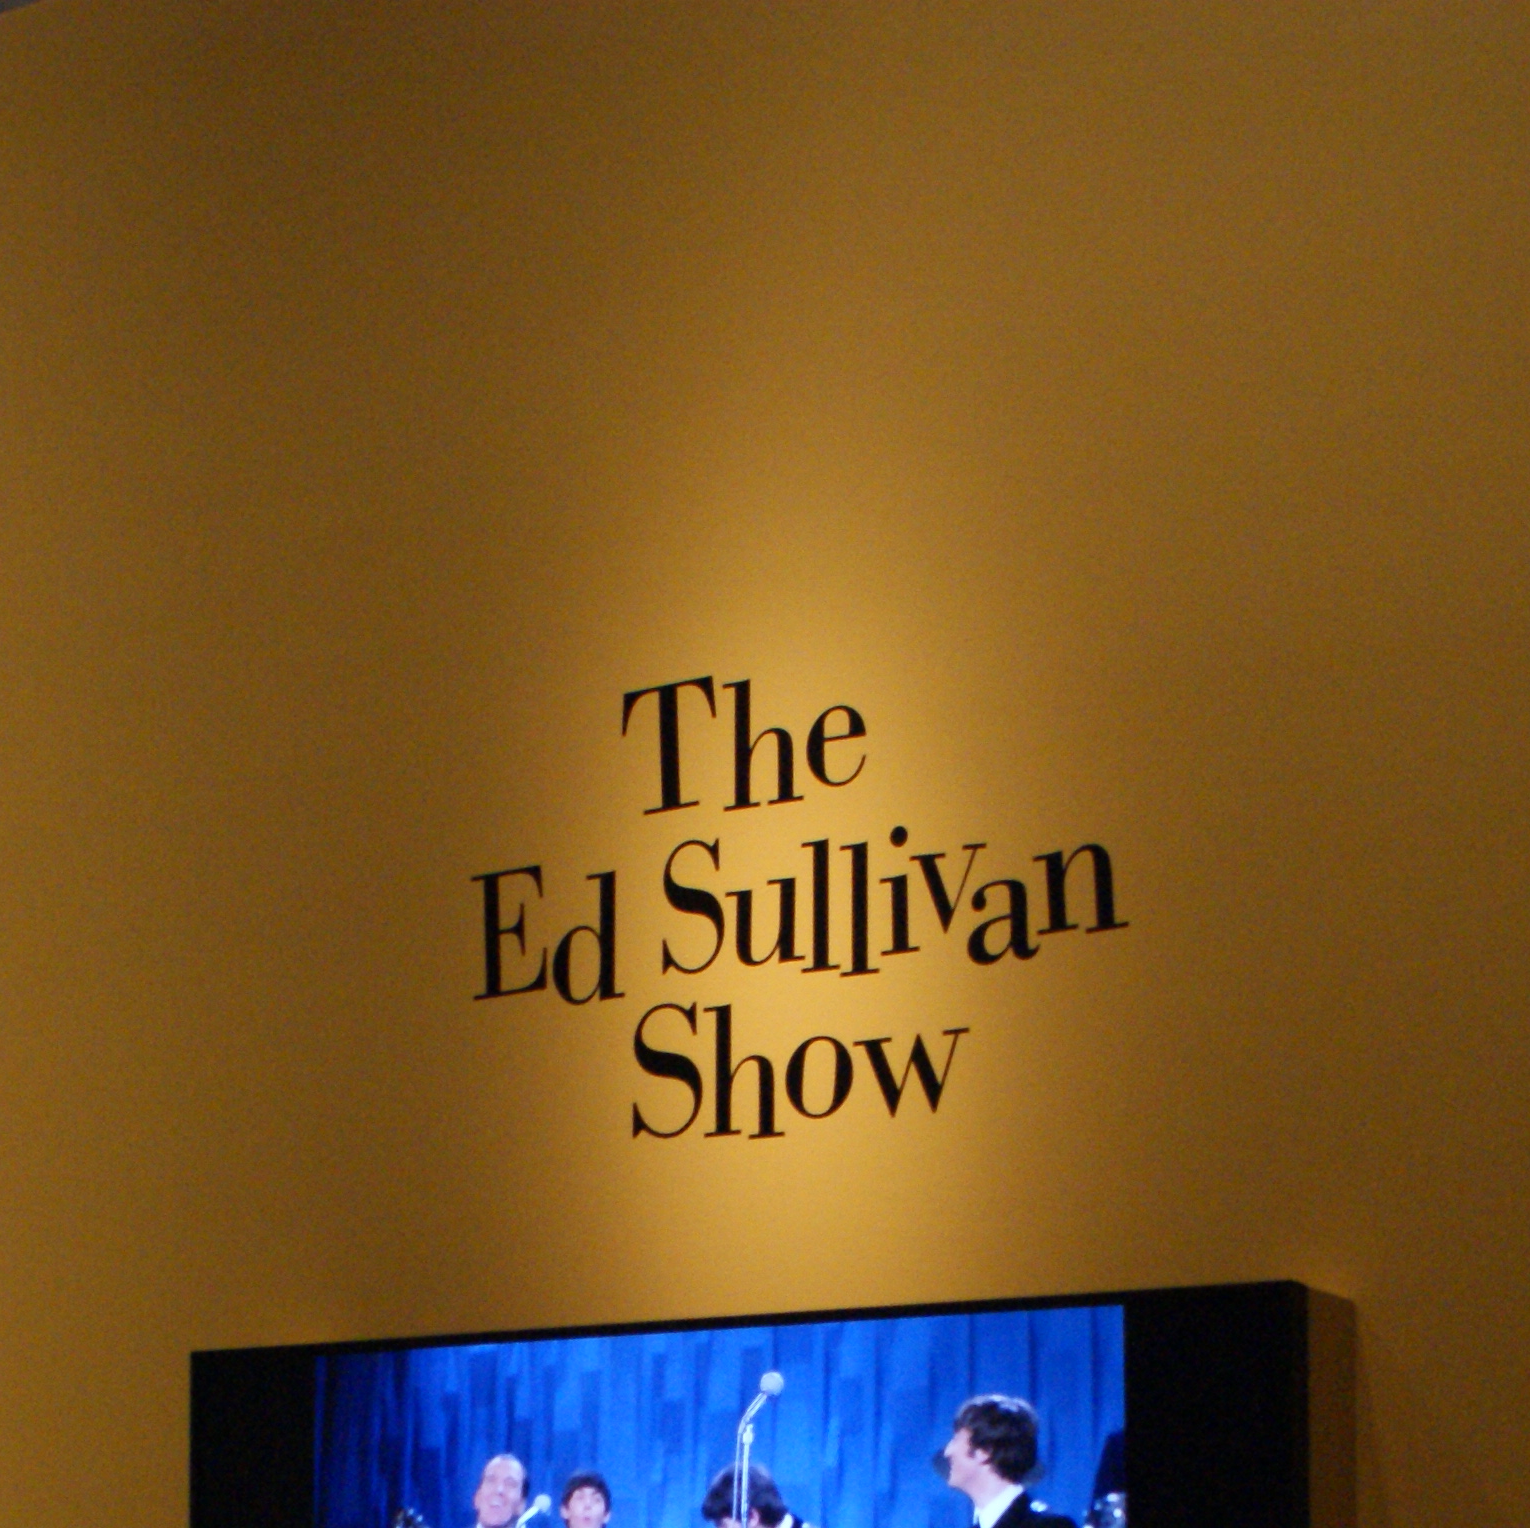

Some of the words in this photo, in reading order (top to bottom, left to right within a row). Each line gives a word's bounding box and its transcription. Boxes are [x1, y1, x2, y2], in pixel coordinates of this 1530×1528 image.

[621, 675, 867, 816] The
[470, 864, 625, 1006] Ed
[661, 825, 1130, 978] Sullivan
[632, 1002, 970, 1140] Show
